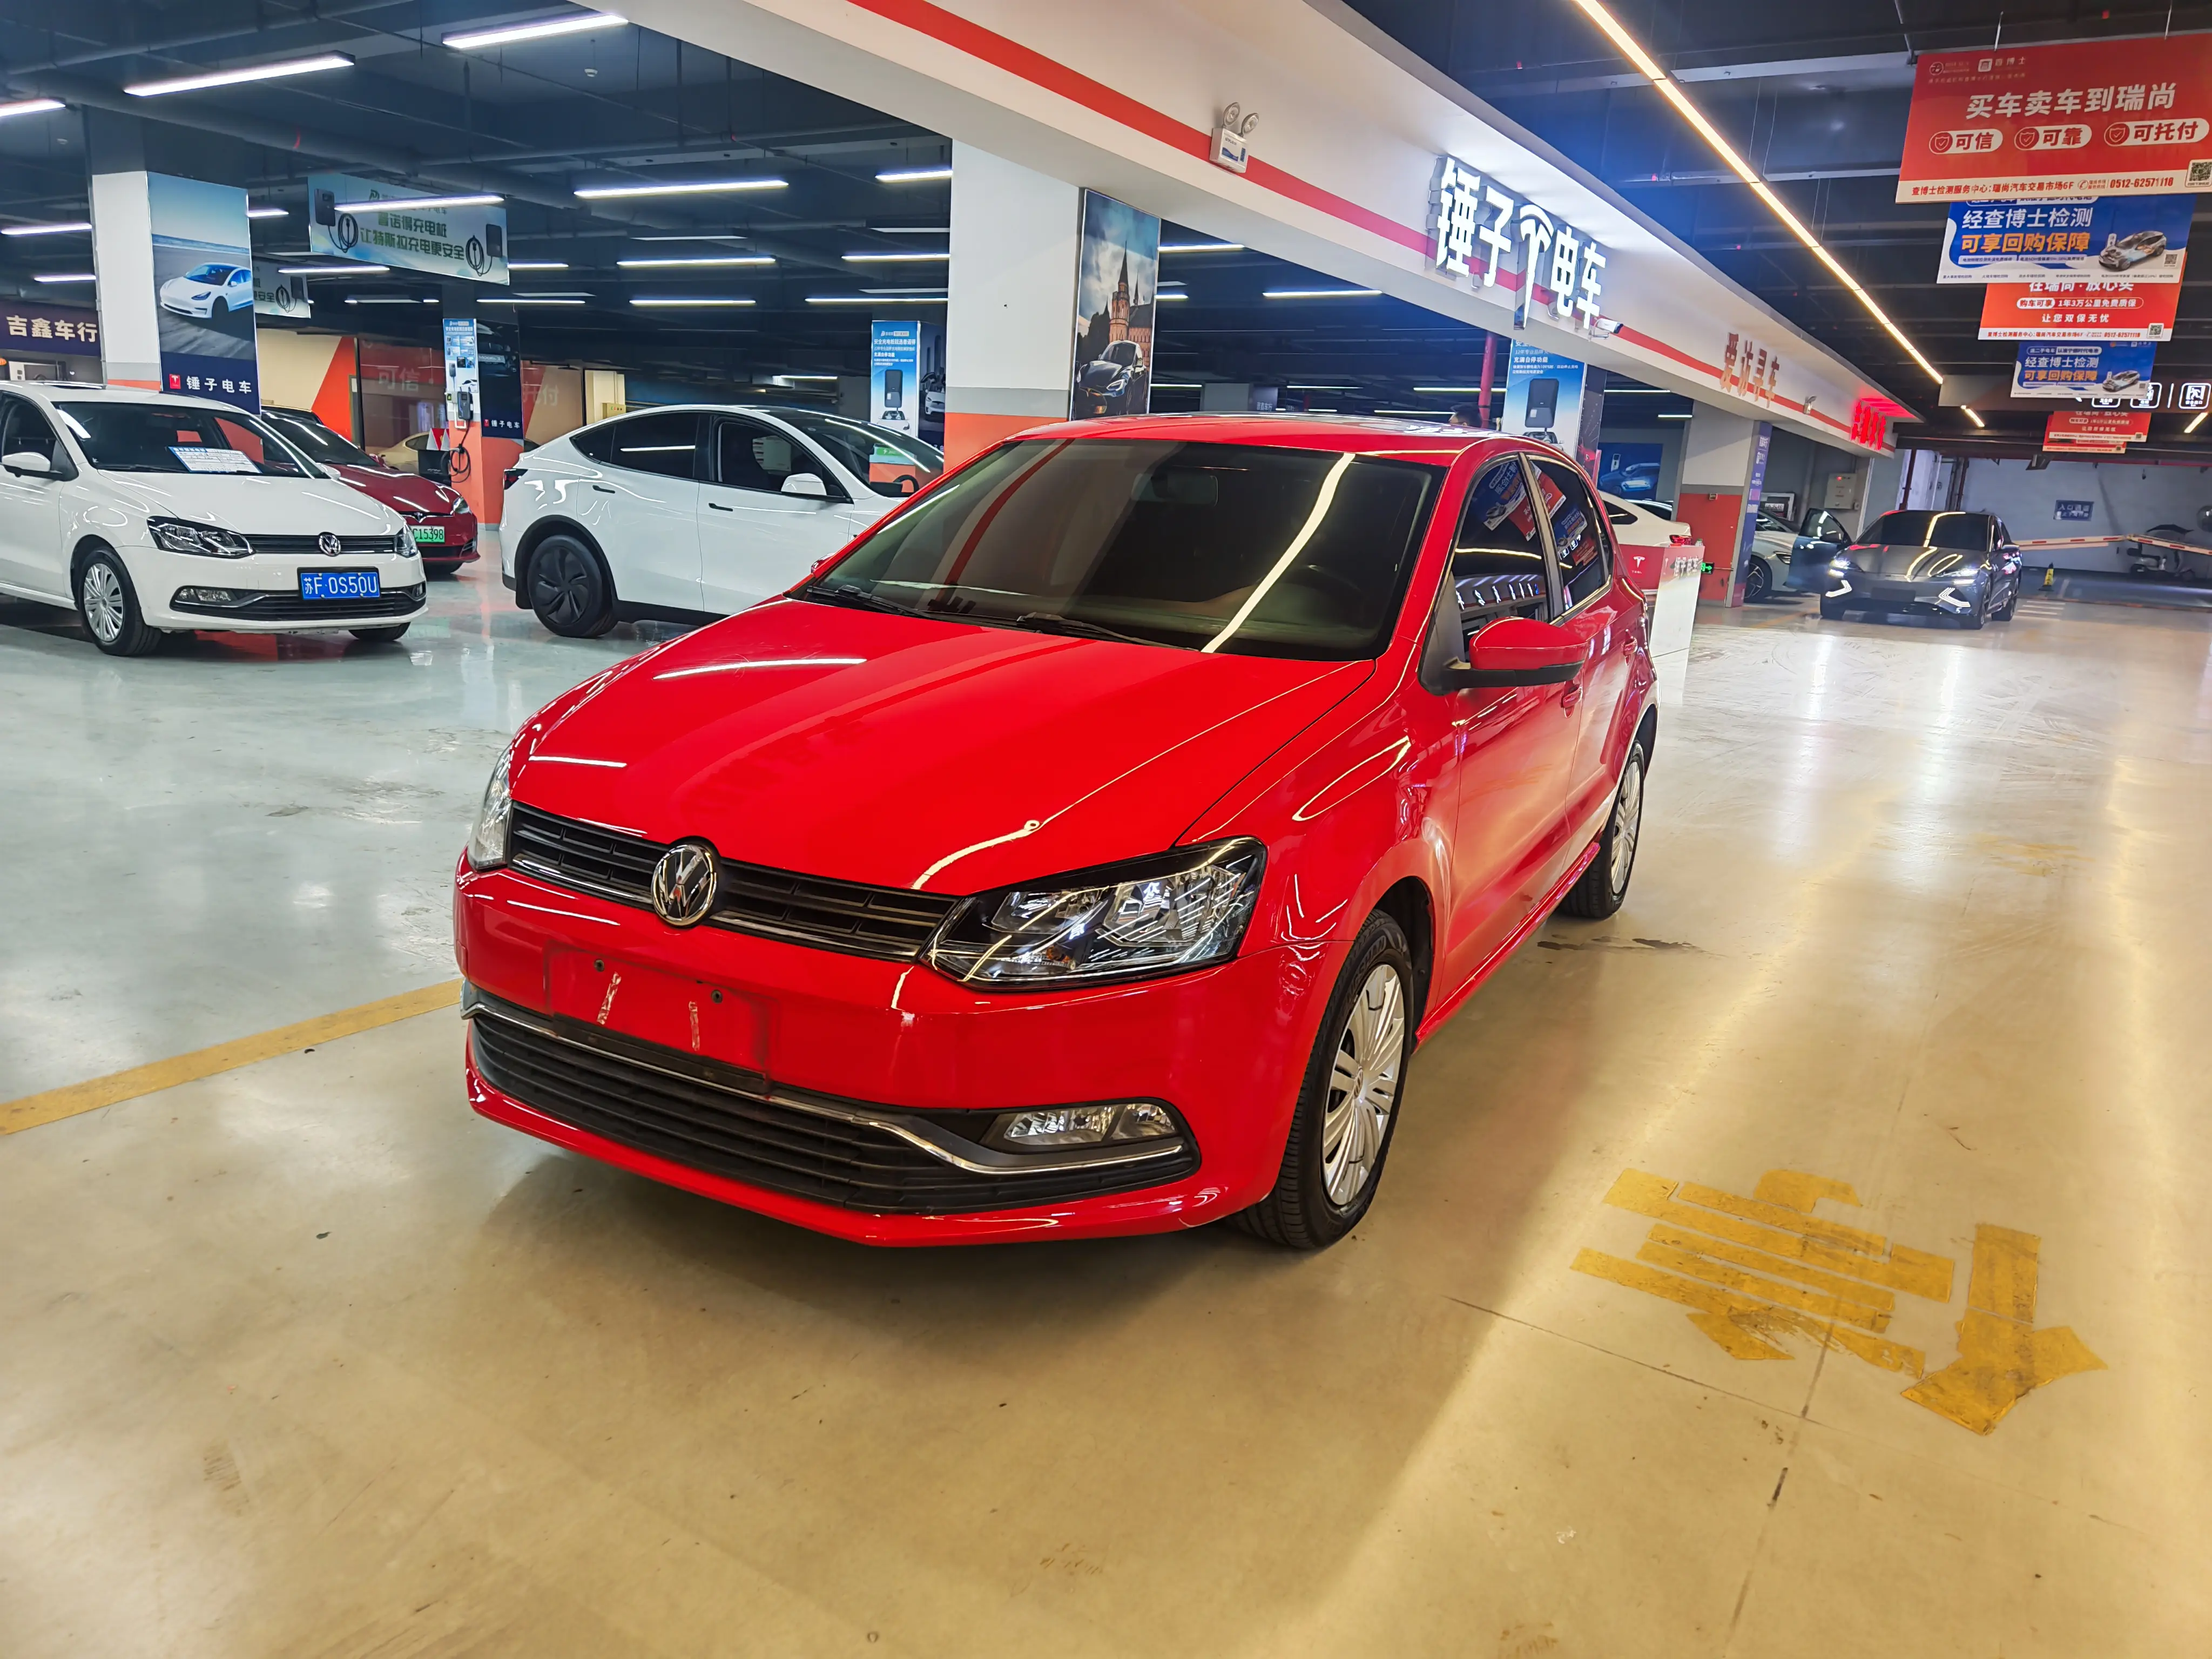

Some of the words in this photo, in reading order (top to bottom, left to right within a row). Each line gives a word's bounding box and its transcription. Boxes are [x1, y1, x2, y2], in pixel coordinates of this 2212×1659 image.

[1966, 83, 2176, 120] 买车卖车到瑞尚
[1955, 132, 1994, 150] 可信
[2042, 127, 2083, 146] 可靠
[2133, 122, 2198, 141] 可托付
[2110, 177, 2174, 188] 0512-62571118
[1961, 207, 2093, 229] 经查博士检测
[360, 227, 464, 260] 让特斯拉充电更安全
[1961, 232, 2090, 253] 可享回购保障
[2020, 299, 2052, 307] 购车可享
[6, 315, 97, 342] 吉鑫车行
[2042, 314, 2109, 323] 让您双保无忧
[2025, 356, 2099, 368] 经查博士检测
[186, 375, 252, 394] 锤子电车
[491, 420, 520, 429] 锤子电车
